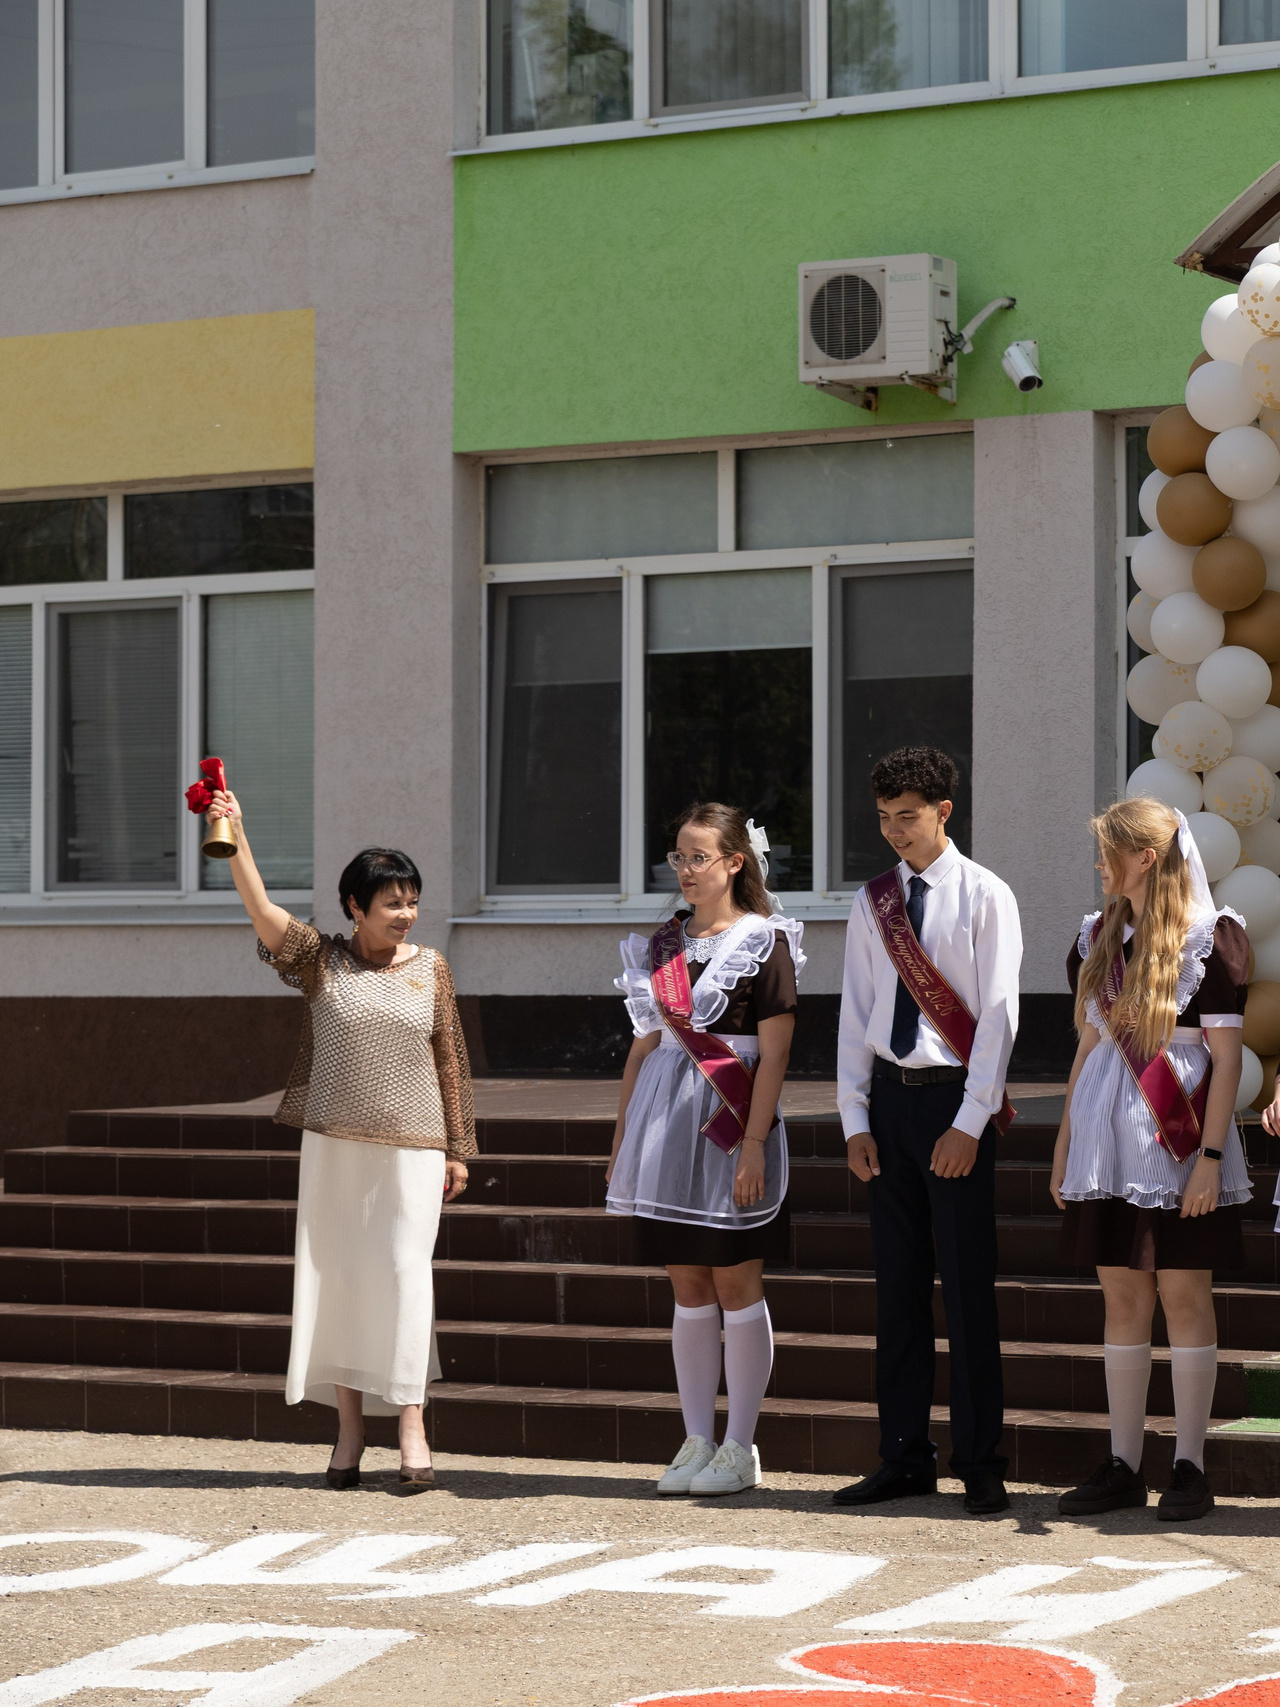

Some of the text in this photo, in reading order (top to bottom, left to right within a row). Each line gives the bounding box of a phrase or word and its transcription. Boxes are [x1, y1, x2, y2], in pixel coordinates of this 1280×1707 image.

[654, 938, 680, 1003] Выпускница
[887, 915, 929, 987] Выпускник
[924, 987, 960, 1016] 2026
